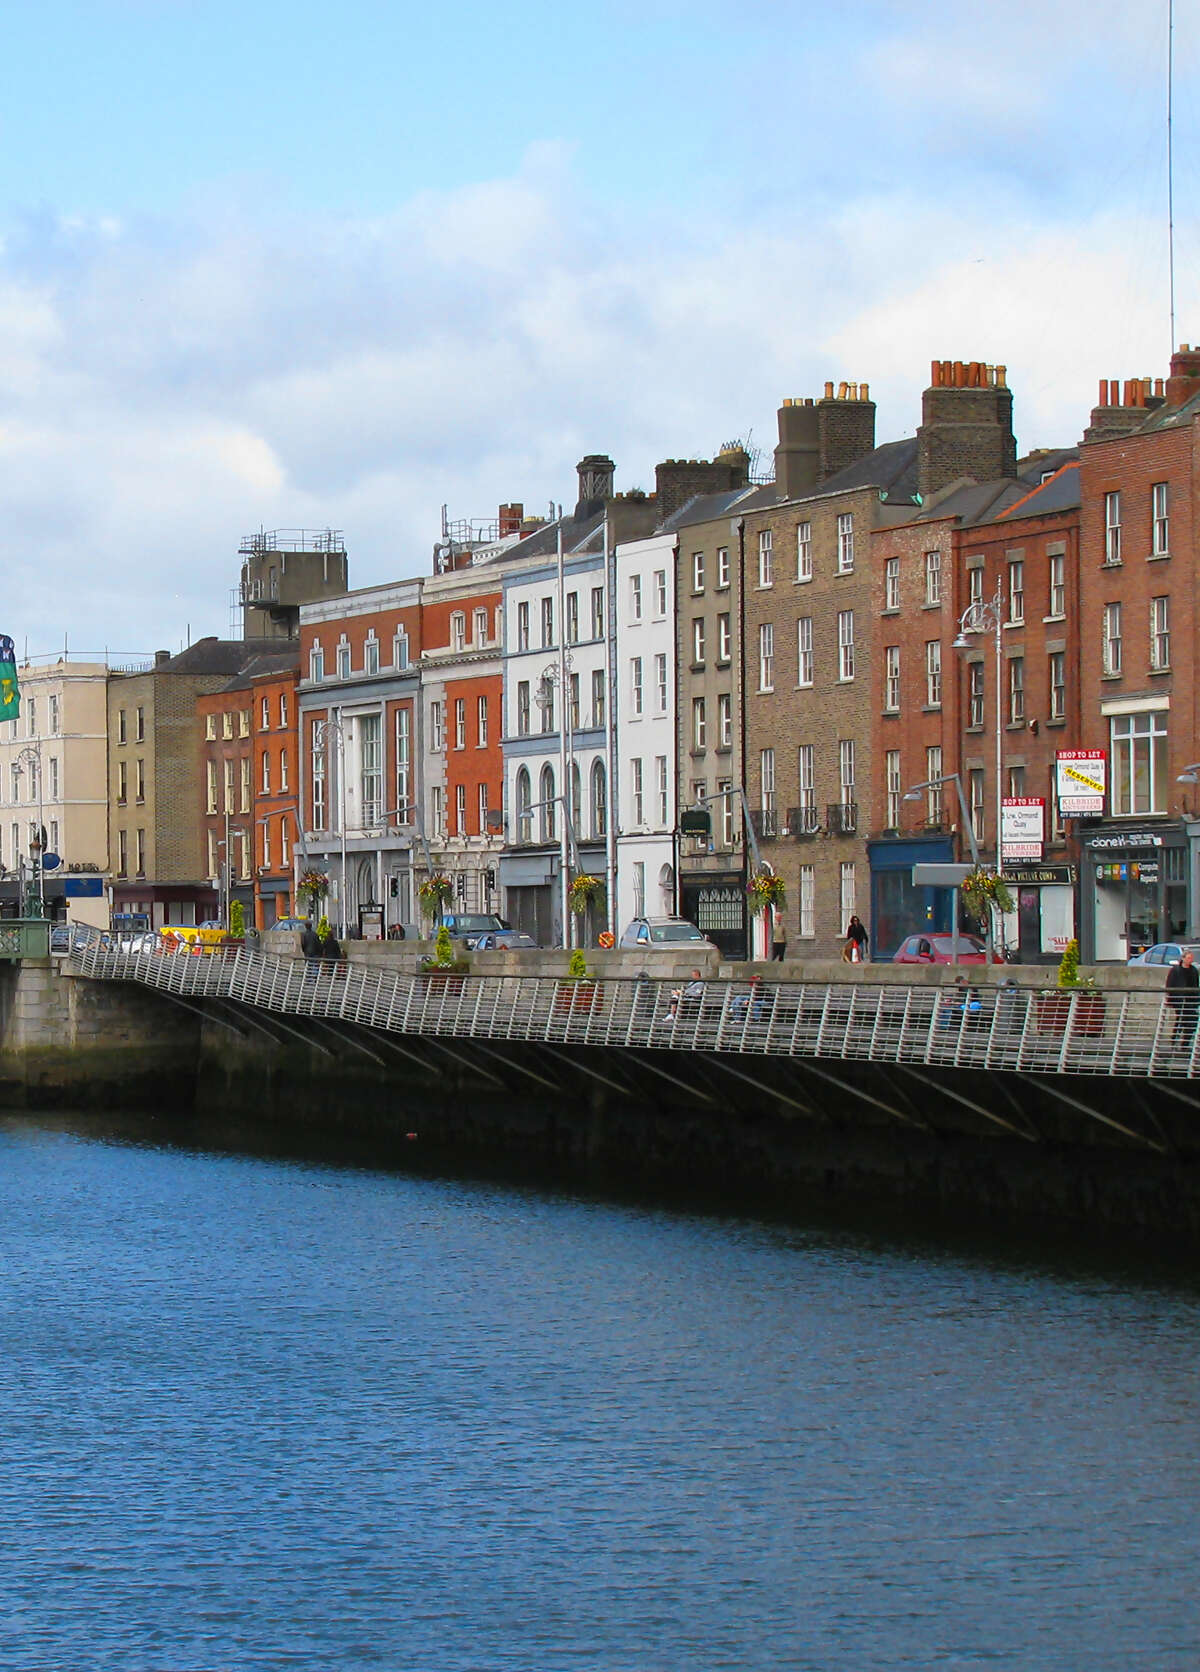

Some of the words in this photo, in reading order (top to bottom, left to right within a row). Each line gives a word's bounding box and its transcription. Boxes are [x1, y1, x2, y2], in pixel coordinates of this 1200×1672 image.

[1059, 751, 1076, 759] SHOP
[1065, 768, 1104, 791] RESERVED
[1001, 798, 1017, 806] HOP
